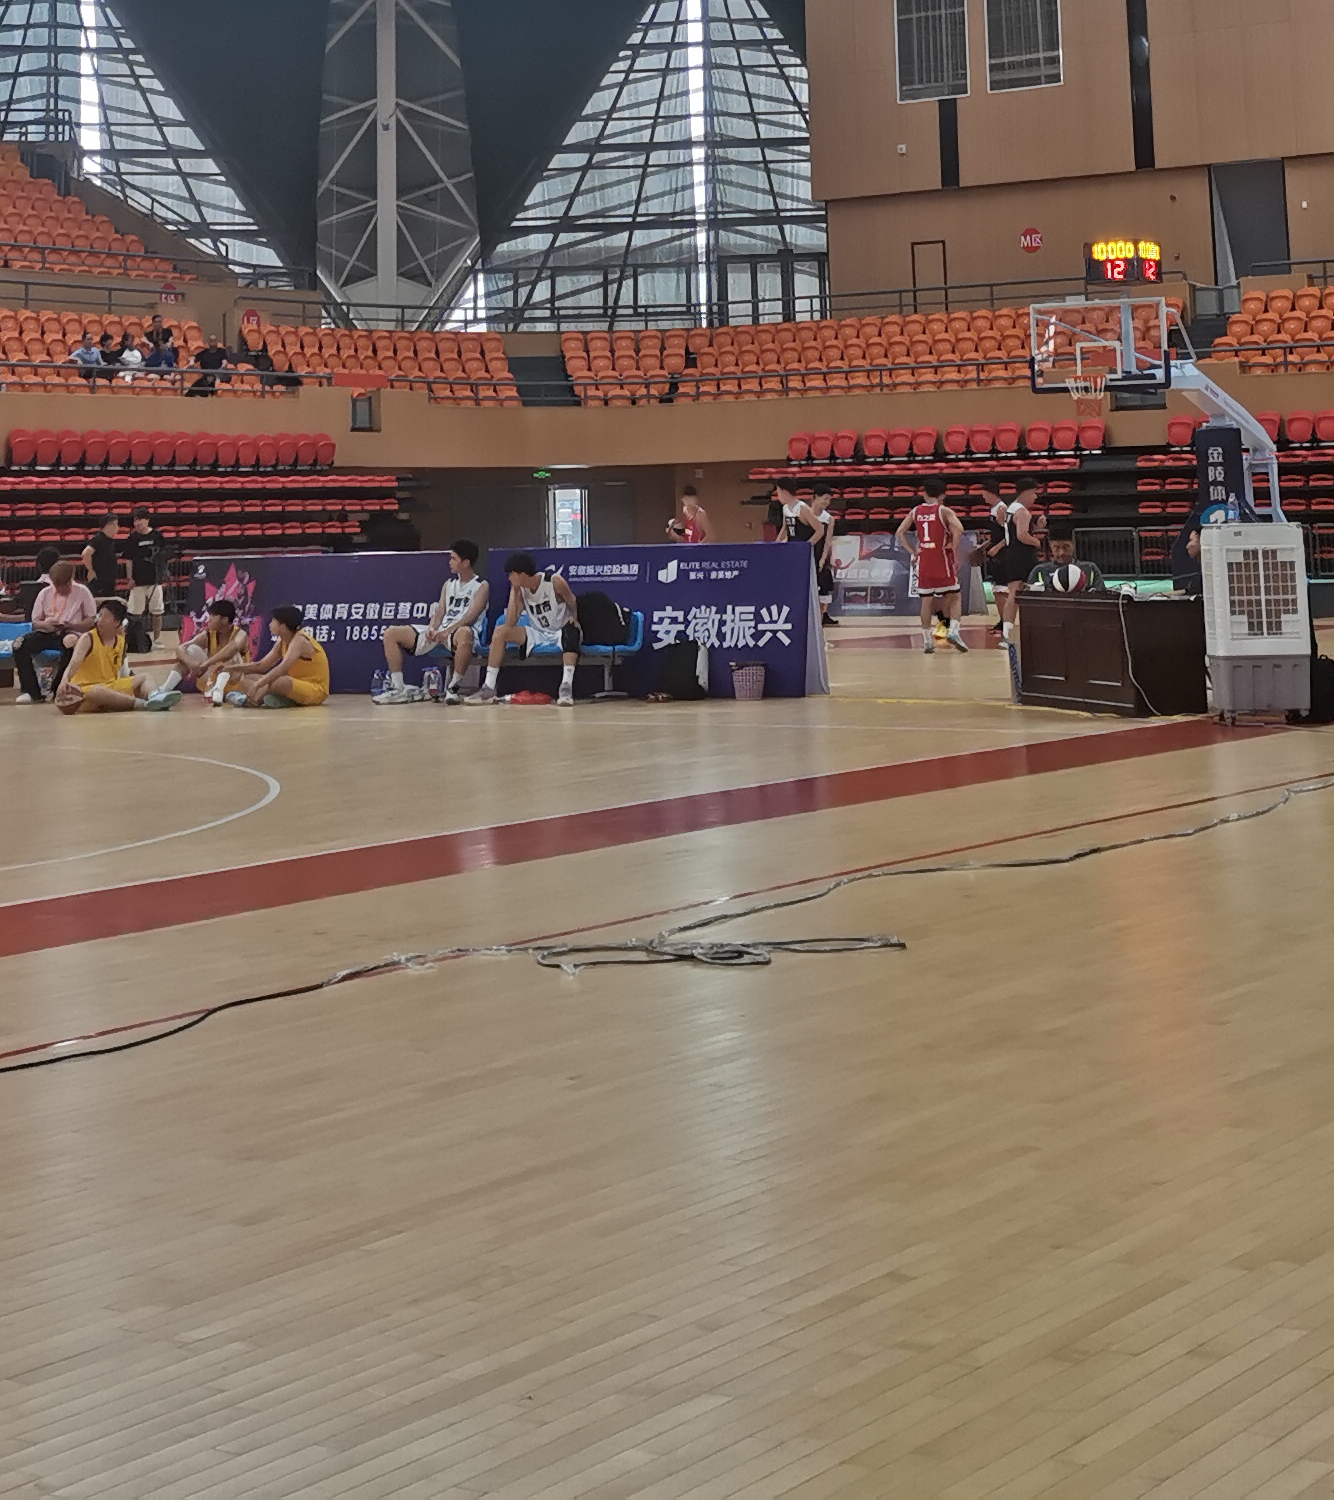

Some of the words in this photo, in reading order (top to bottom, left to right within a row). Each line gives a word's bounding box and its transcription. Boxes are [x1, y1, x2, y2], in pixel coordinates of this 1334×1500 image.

[1020, 233, 1043, 247] M区
[1105, 260, 1125, 279] 12
[922, 521, 931, 541] 1
[701, 561, 720, 569] REAL
[720, 560, 748, 569] ESTATE
[651, 604, 793, 651] 安徽振兴
